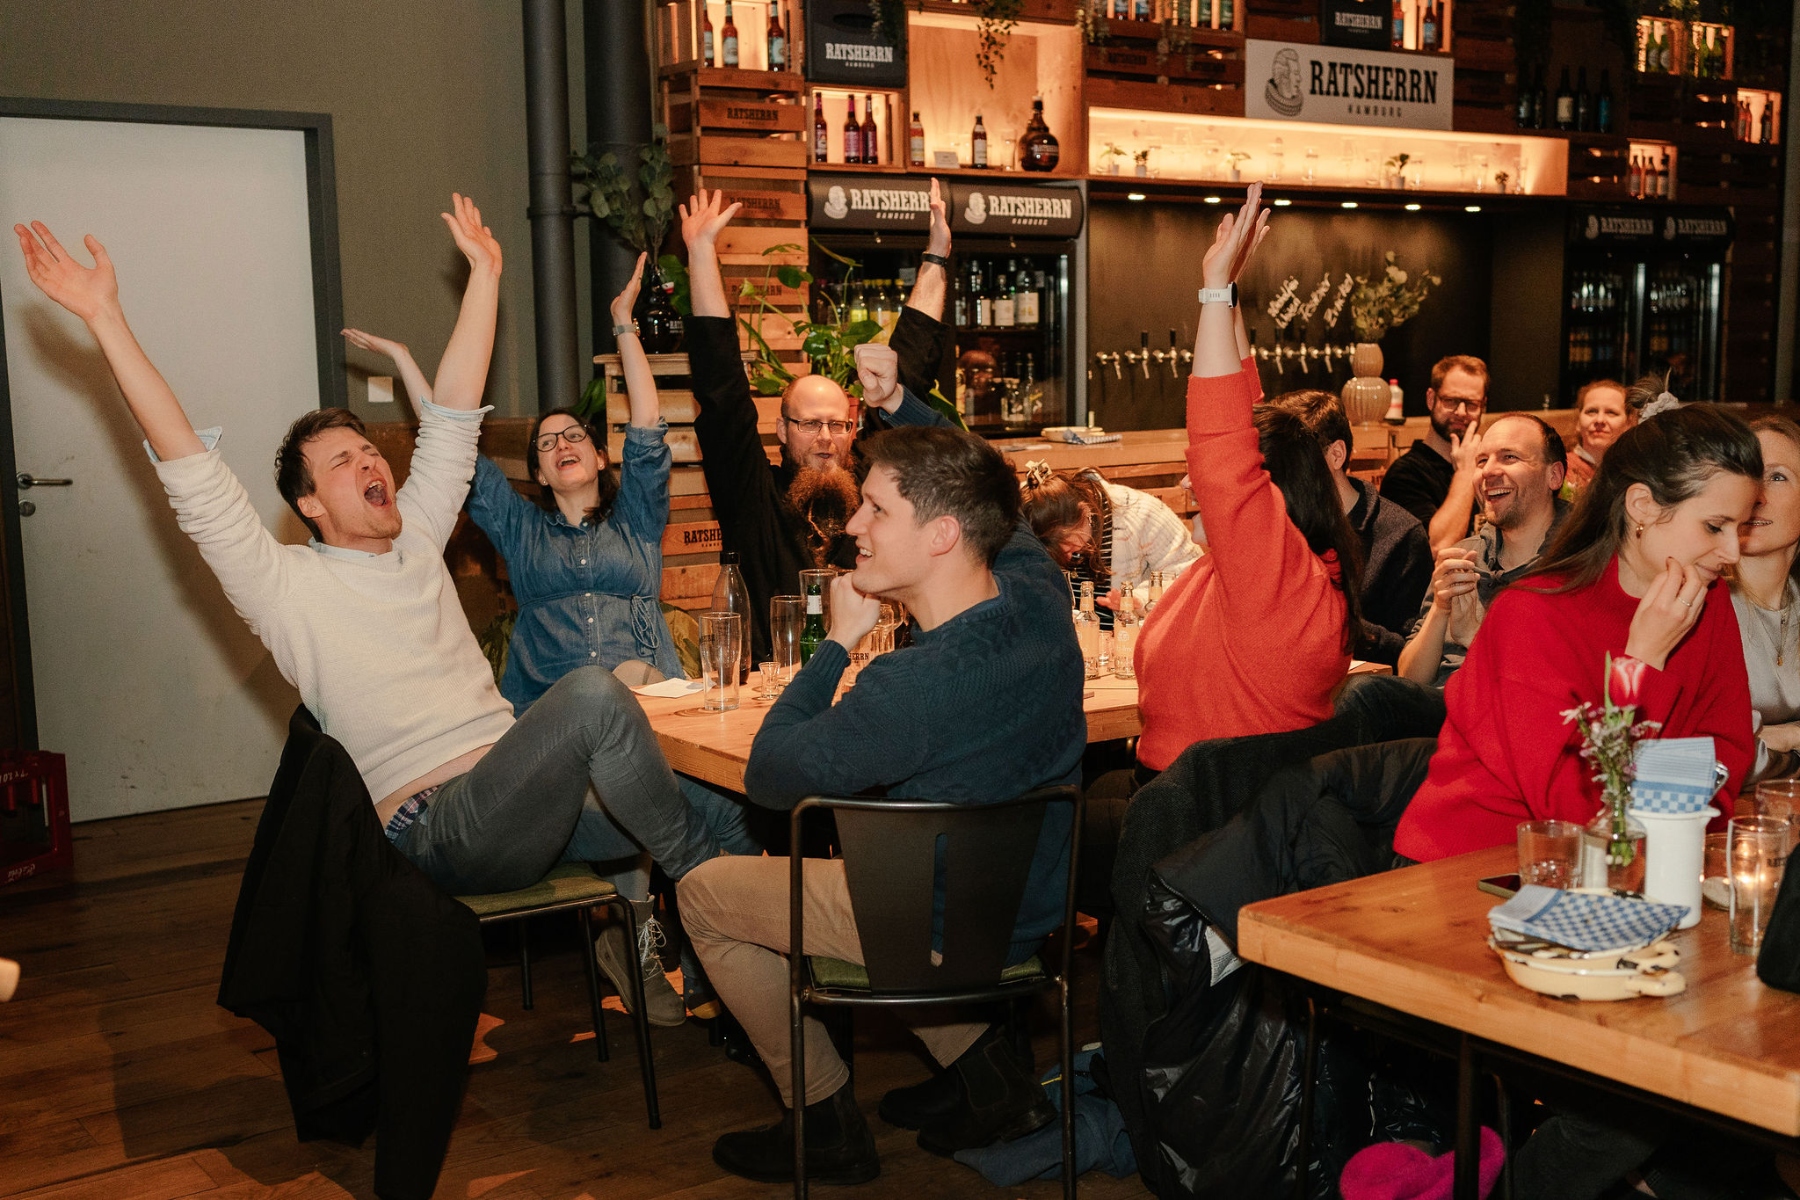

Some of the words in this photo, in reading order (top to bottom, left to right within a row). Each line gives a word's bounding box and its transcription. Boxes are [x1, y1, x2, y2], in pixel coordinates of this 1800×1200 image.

[1334, 11, 1383, 29] RATSHERRN
[825, 42, 893, 63] RATSHERRN
[1309, 59, 1438, 104] RATSHERRN
[727, 107, 779, 121] RATSHERRN
[1348, 103, 1402, 118] HAMBURG
[849, 188, 932, 212] RATSHERR
[988, 195, 1072, 219] RATSHERRN
[1601, 217, 1653, 234] RATSHERRN
[684, 528, 723, 544] RATSHE
